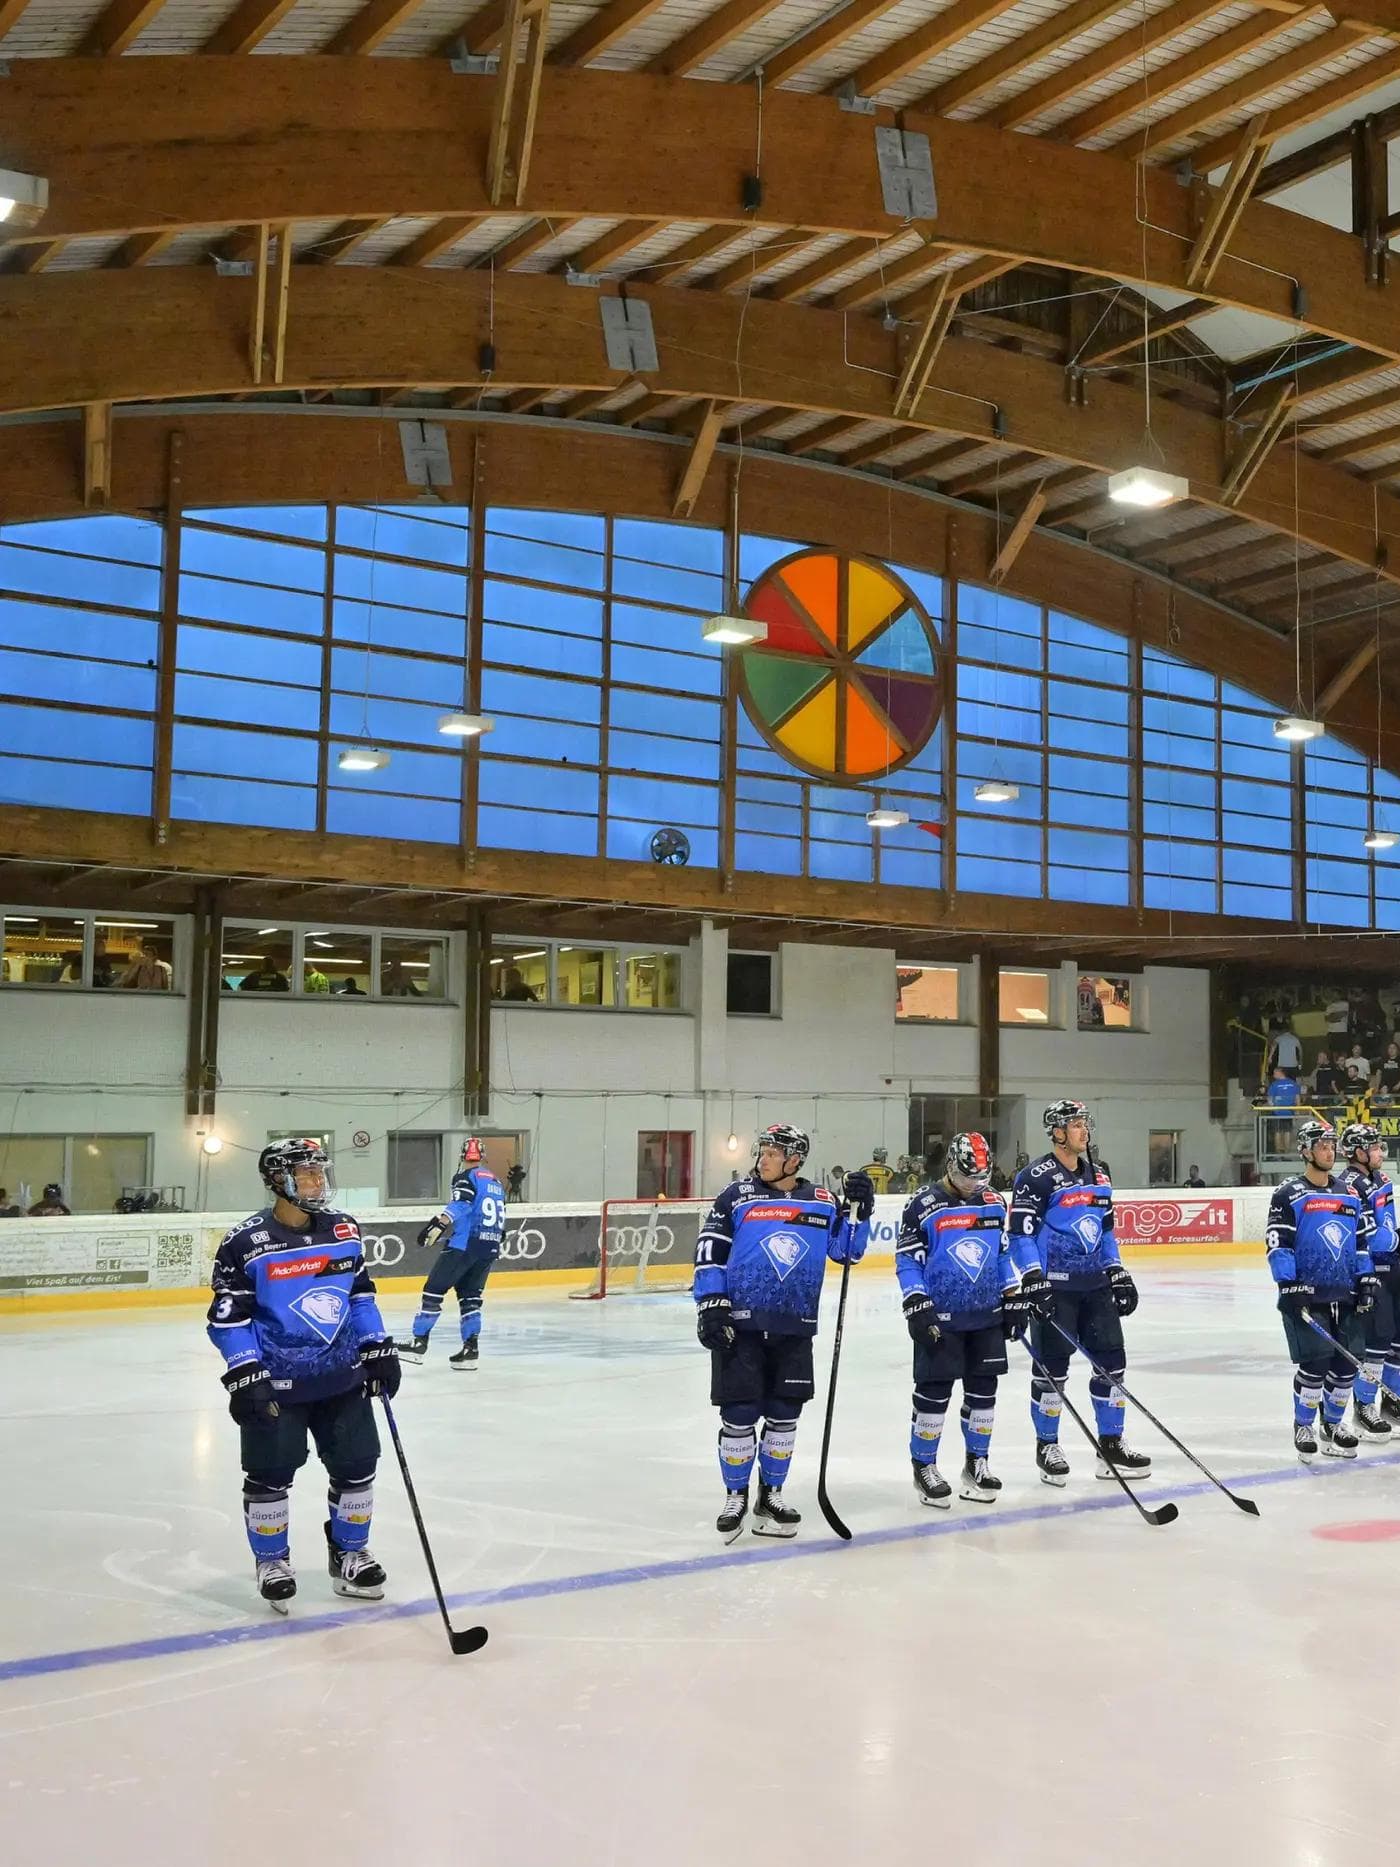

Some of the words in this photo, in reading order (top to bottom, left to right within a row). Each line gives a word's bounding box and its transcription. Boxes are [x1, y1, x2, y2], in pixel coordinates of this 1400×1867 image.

[481, 1197, 506, 1230] 93
[696, 1240, 713, 1262] 11
[26, 1277, 44, 1287] Viel
[216, 1296, 233, 1319] 3
